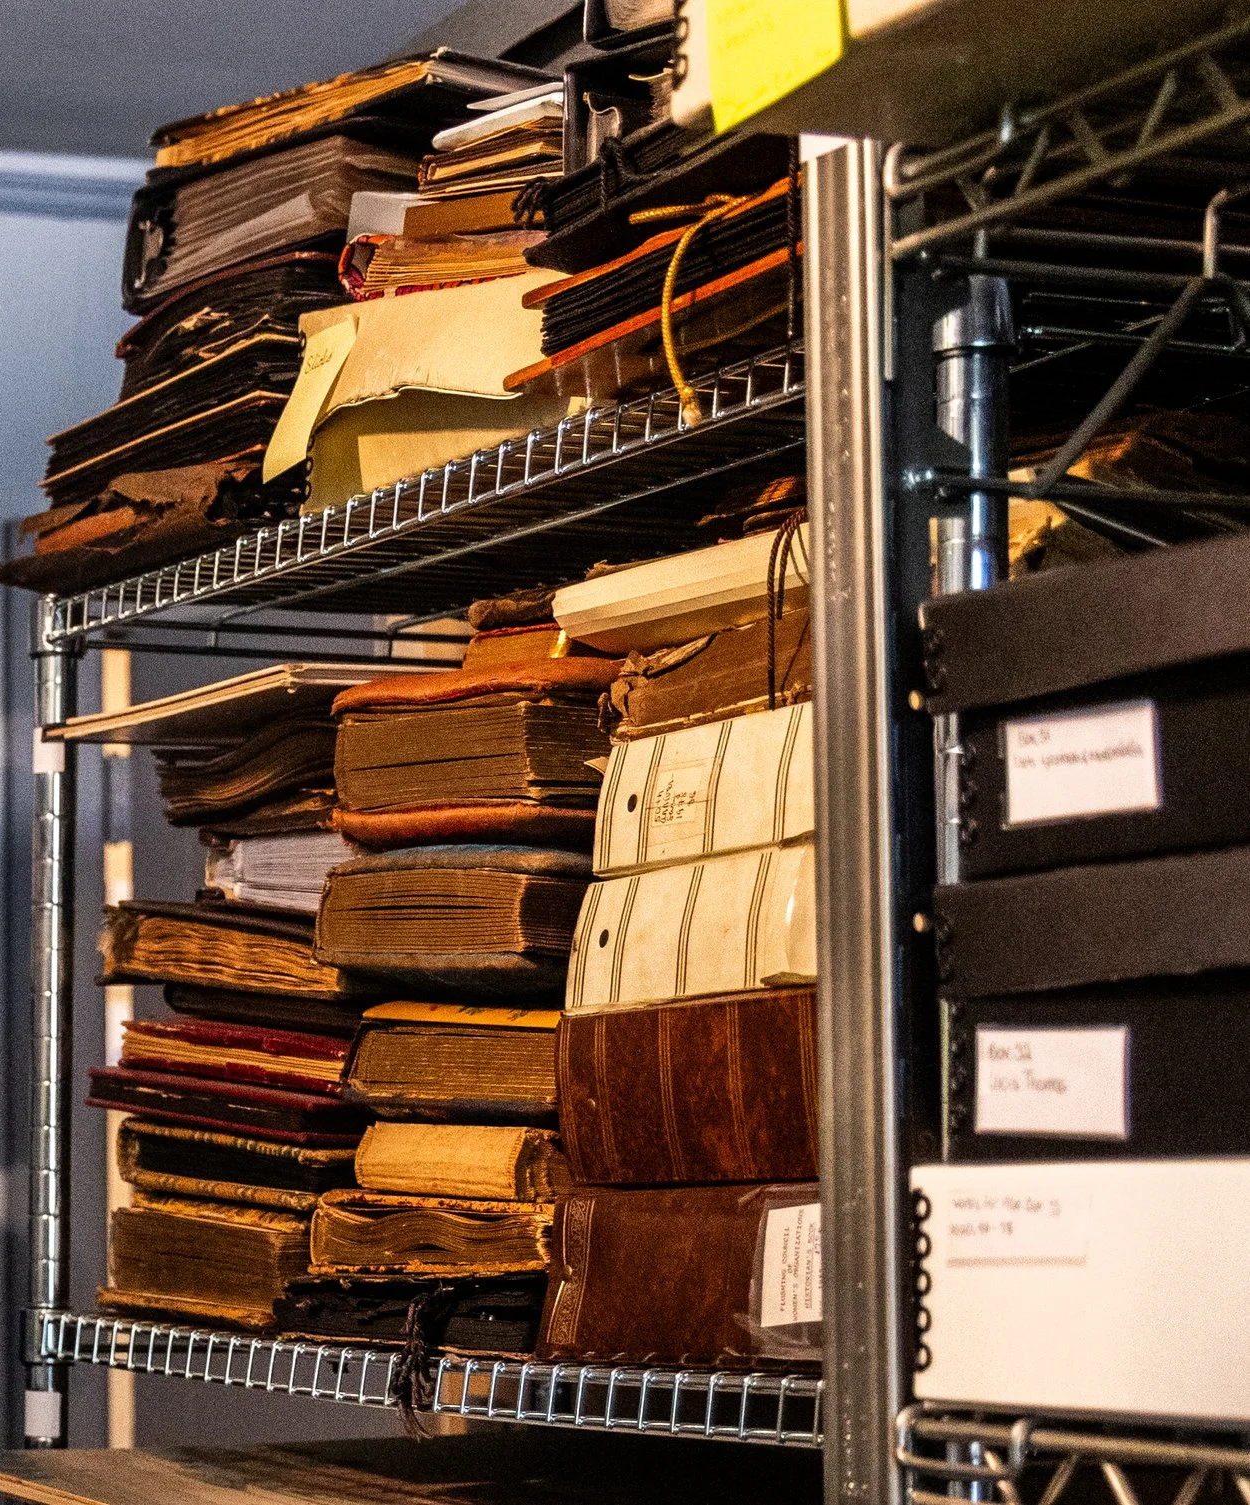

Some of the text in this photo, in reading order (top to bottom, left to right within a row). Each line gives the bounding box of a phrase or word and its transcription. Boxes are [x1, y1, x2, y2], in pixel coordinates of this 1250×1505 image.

[782, 1226, 790, 1265] COUNCIL
[793, 1208, 804, 1278] ORGANIZATIONS
[807, 1222, 815, 1244] BOOK
[787, 1264, 793, 1274] OF
